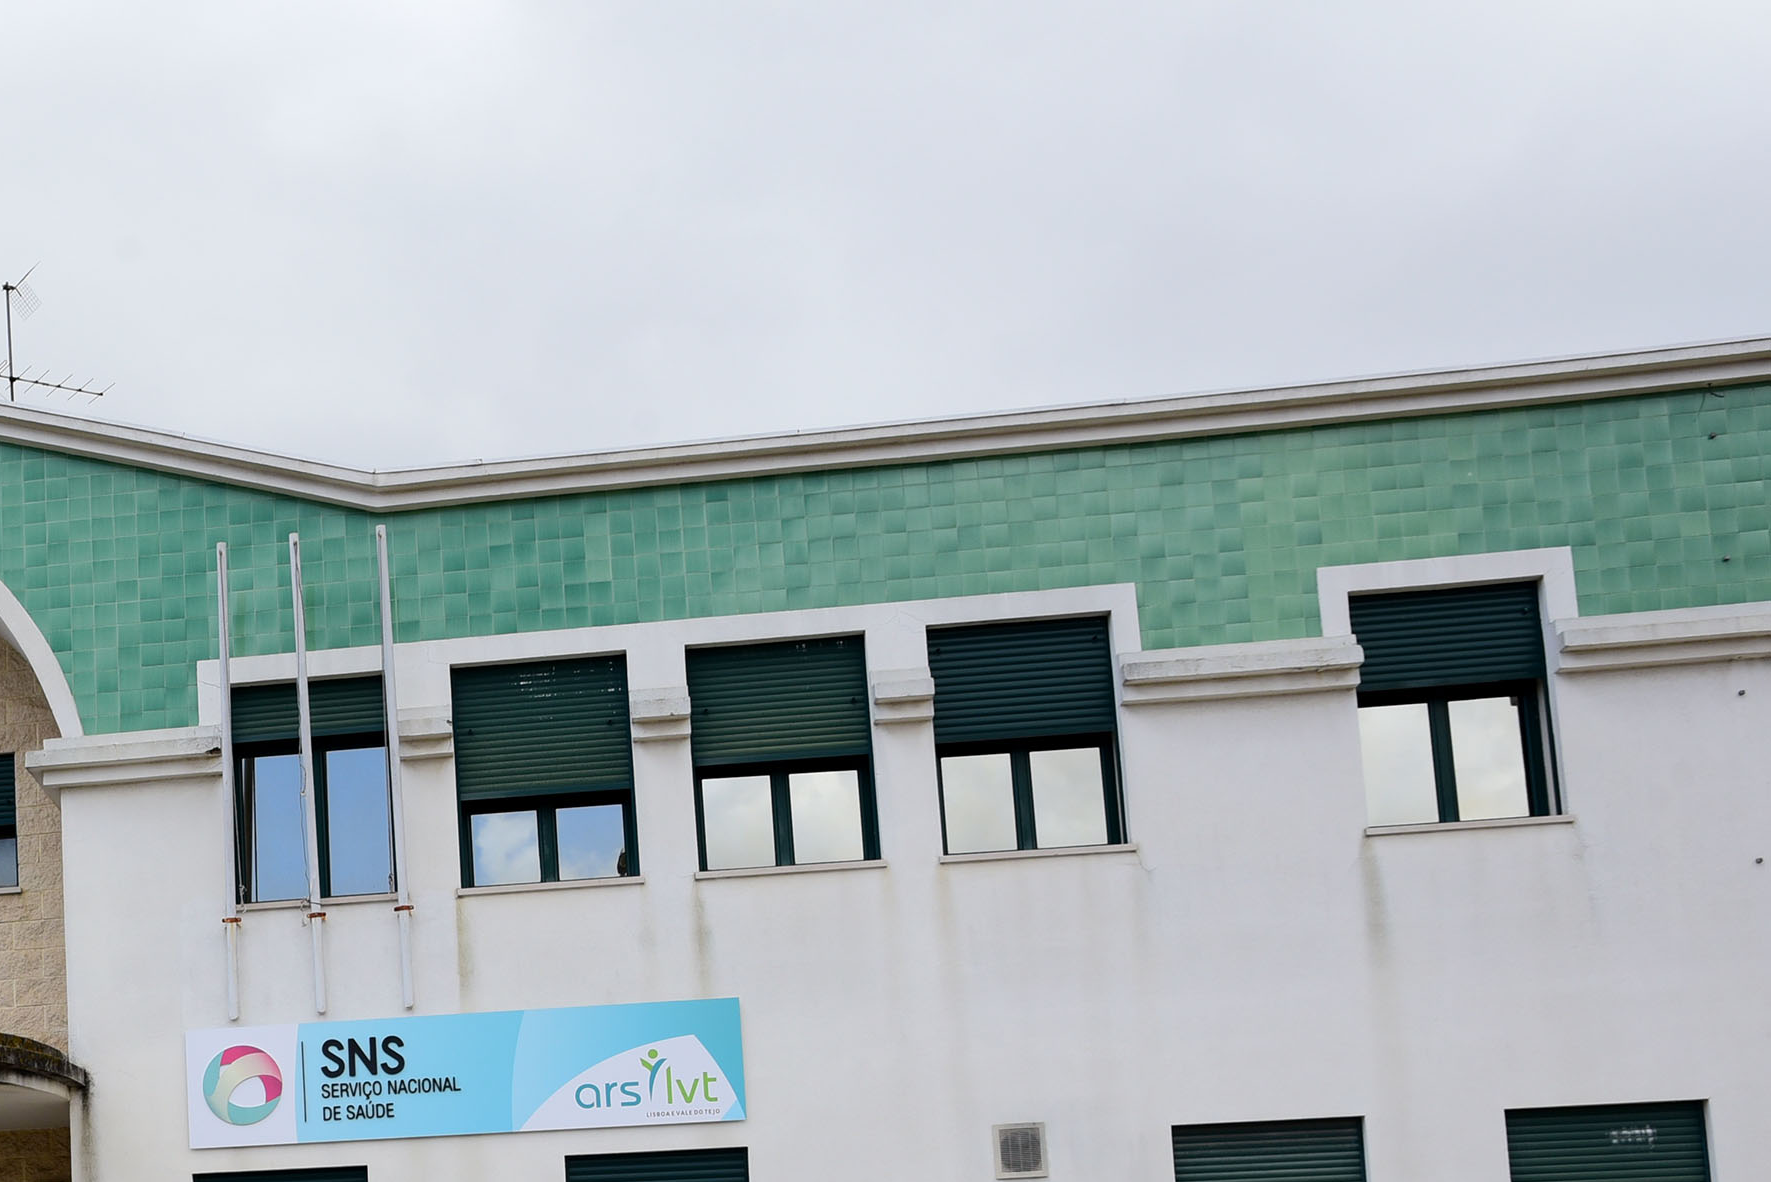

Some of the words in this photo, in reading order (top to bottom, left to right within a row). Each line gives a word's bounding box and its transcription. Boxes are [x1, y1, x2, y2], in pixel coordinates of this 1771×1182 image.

[321, 1035, 405, 1078] SNS
[321, 1080, 382, 1100] SERVIÇO
[387, 1076, 461, 1095] NACIONAL
[575, 1081, 642, 1109] ars
[666, 1065, 718, 1104] lvt
[323, 1105, 342, 1121] DE
[346, 1101, 395, 1120] SAÚDE
[646, 1110, 670, 1118] LISBOA
